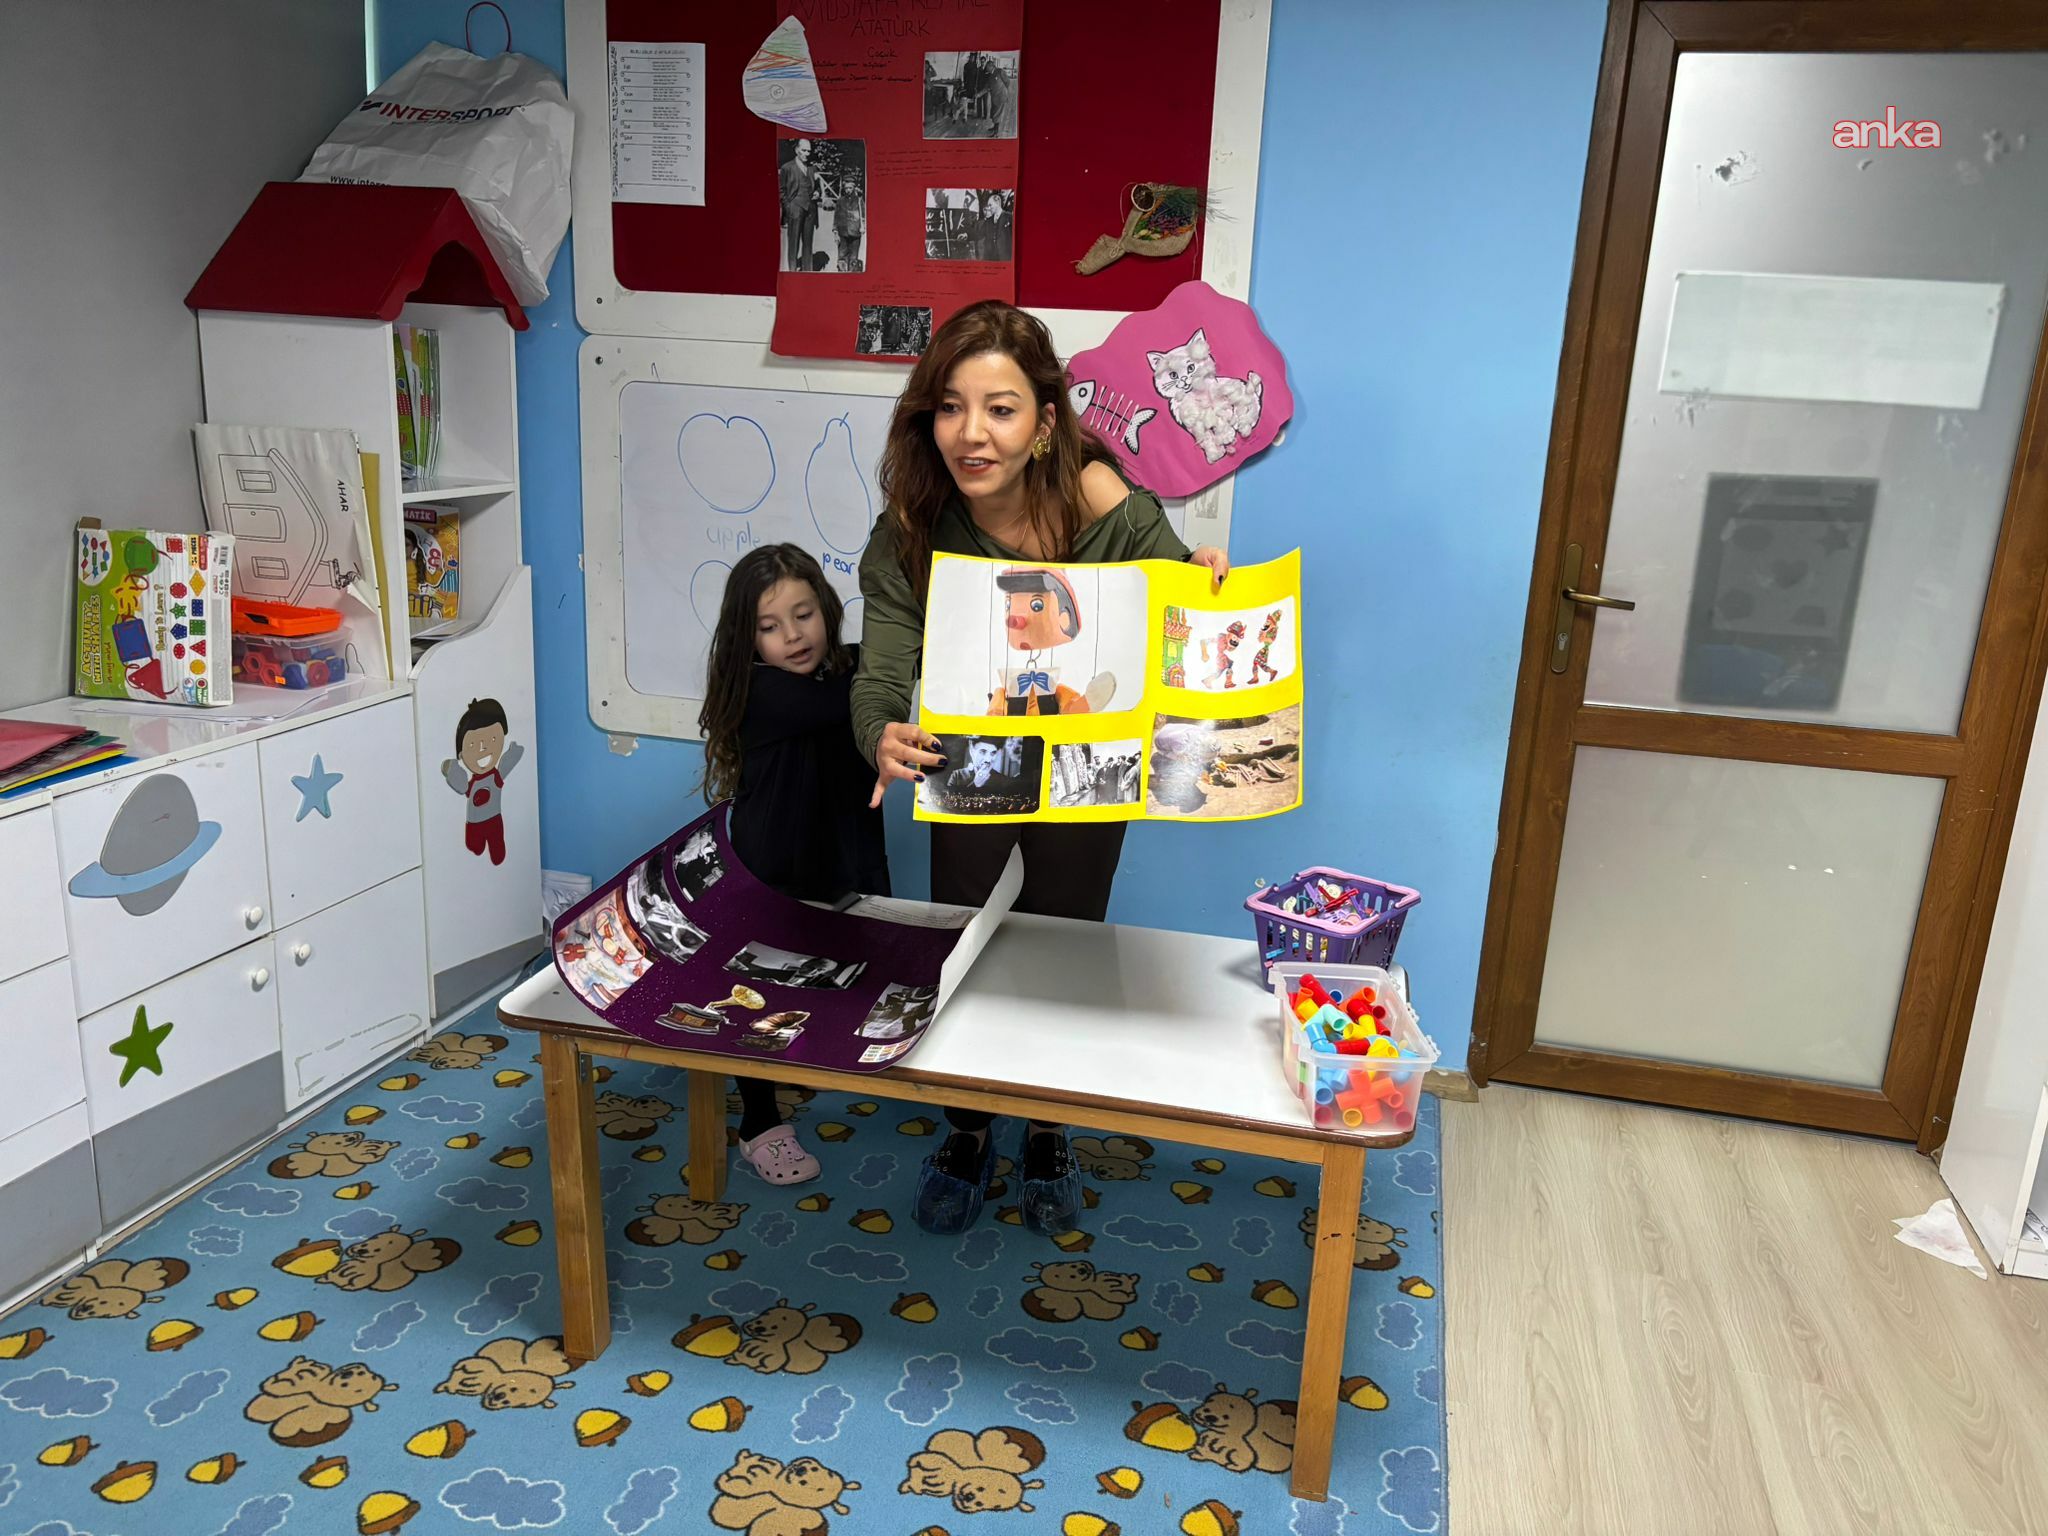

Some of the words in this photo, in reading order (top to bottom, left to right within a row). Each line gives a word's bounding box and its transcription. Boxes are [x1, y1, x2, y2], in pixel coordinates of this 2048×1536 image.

[822, 552, 856, 575] pear
[81, 602, 92, 675] ACTIVITY
[90, 595, 102, 653] SHAPES
[93, 655, 103, 684] WITH
